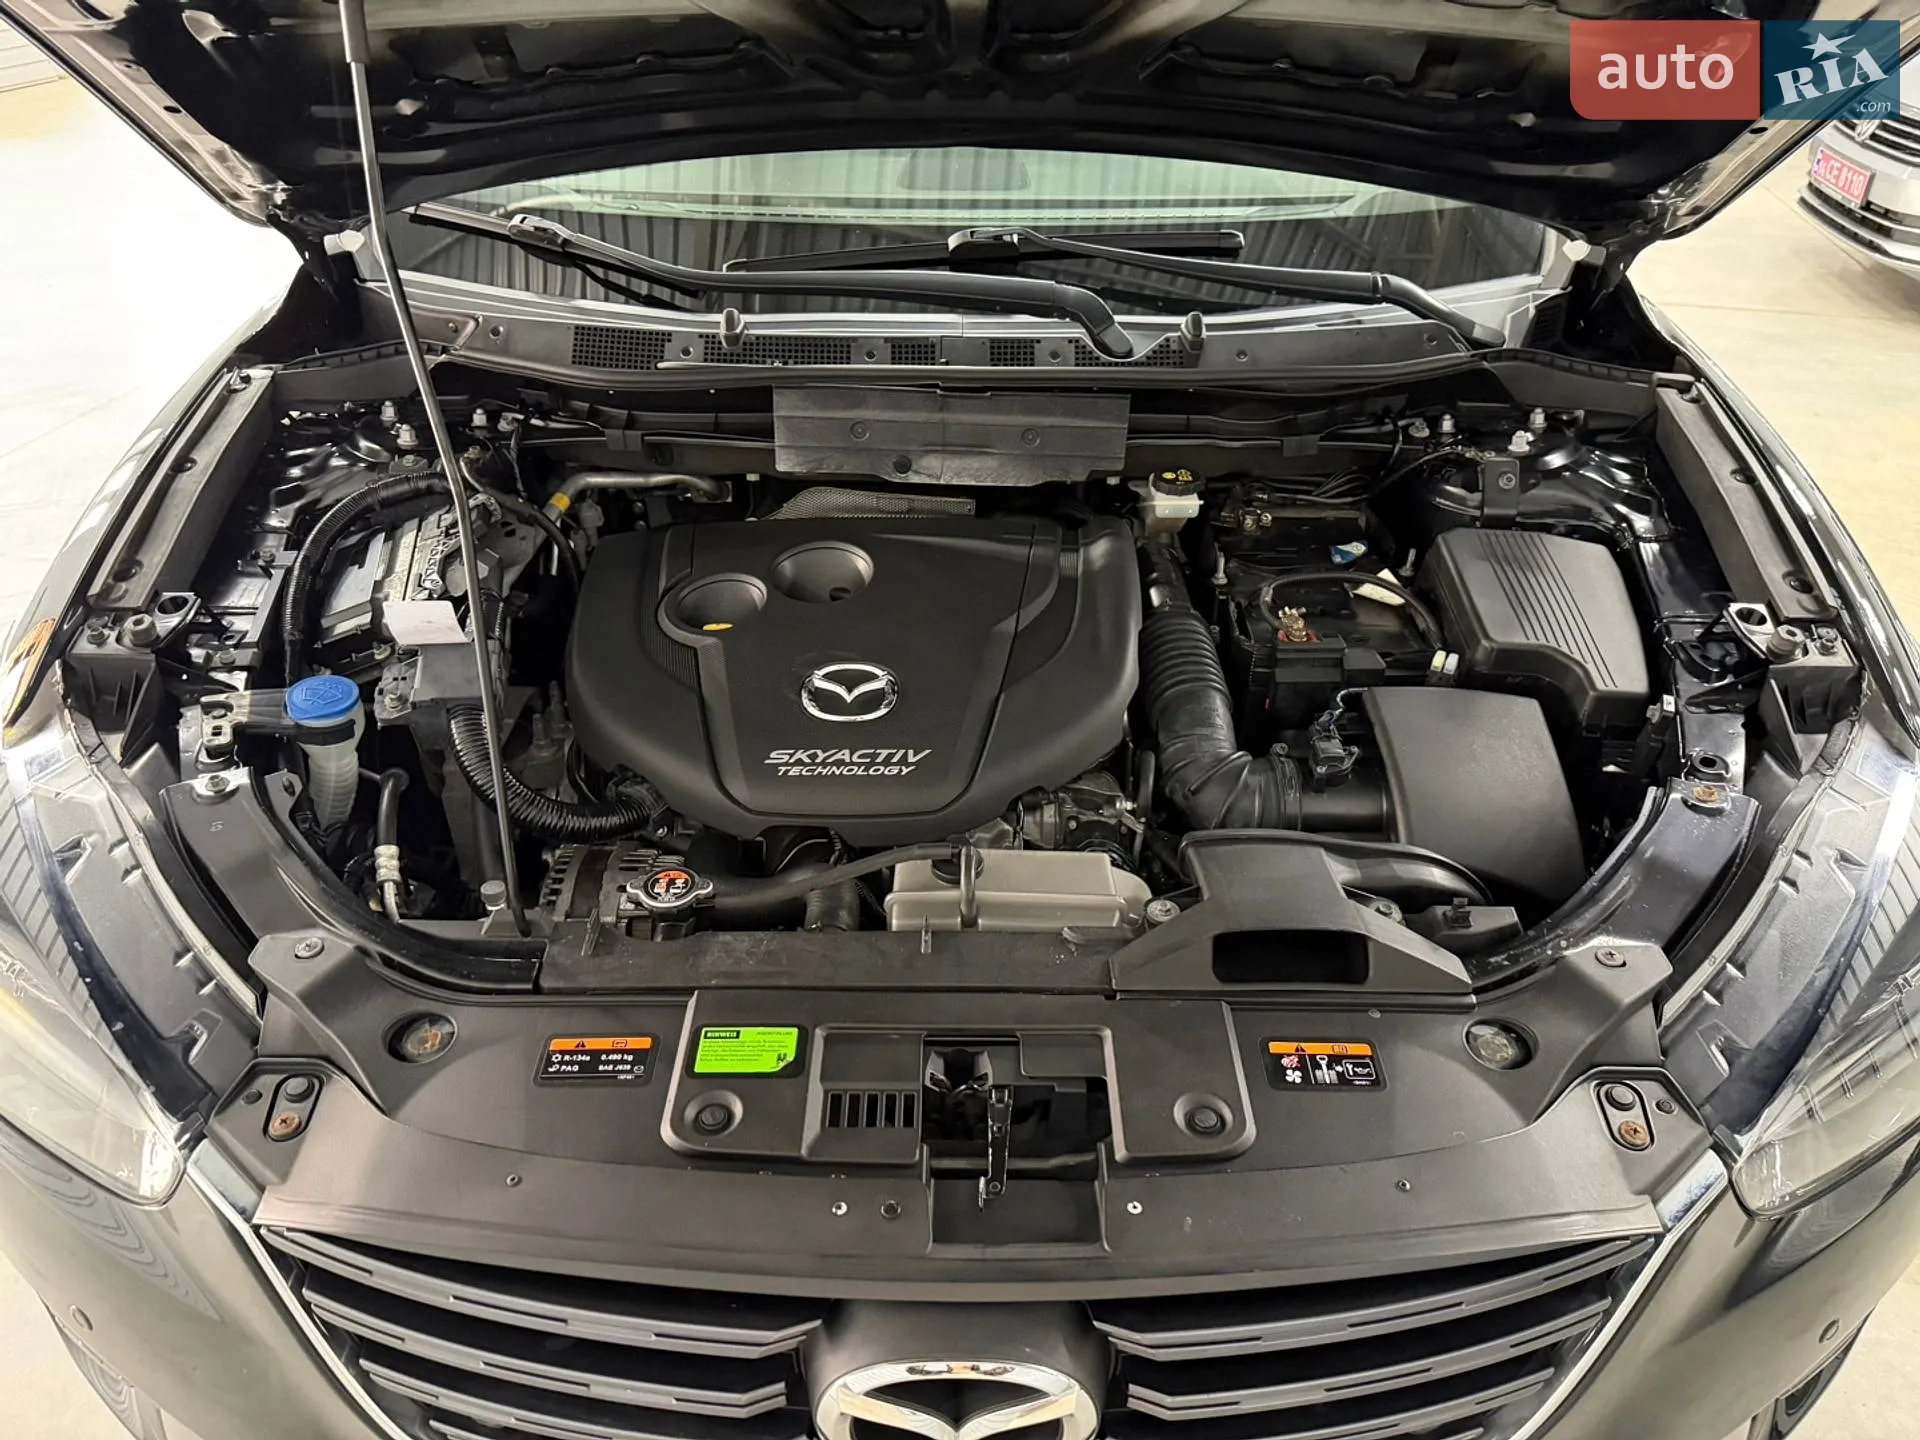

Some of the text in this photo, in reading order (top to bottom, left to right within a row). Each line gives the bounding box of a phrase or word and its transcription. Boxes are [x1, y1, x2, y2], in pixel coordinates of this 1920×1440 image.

[764, 749, 932, 764] SKYACTIV
[777, 765, 916, 776] TECHNOLOGY
[562, 1054, 591, 1062] R-134a
[623, 1053, 634, 1062] kg
